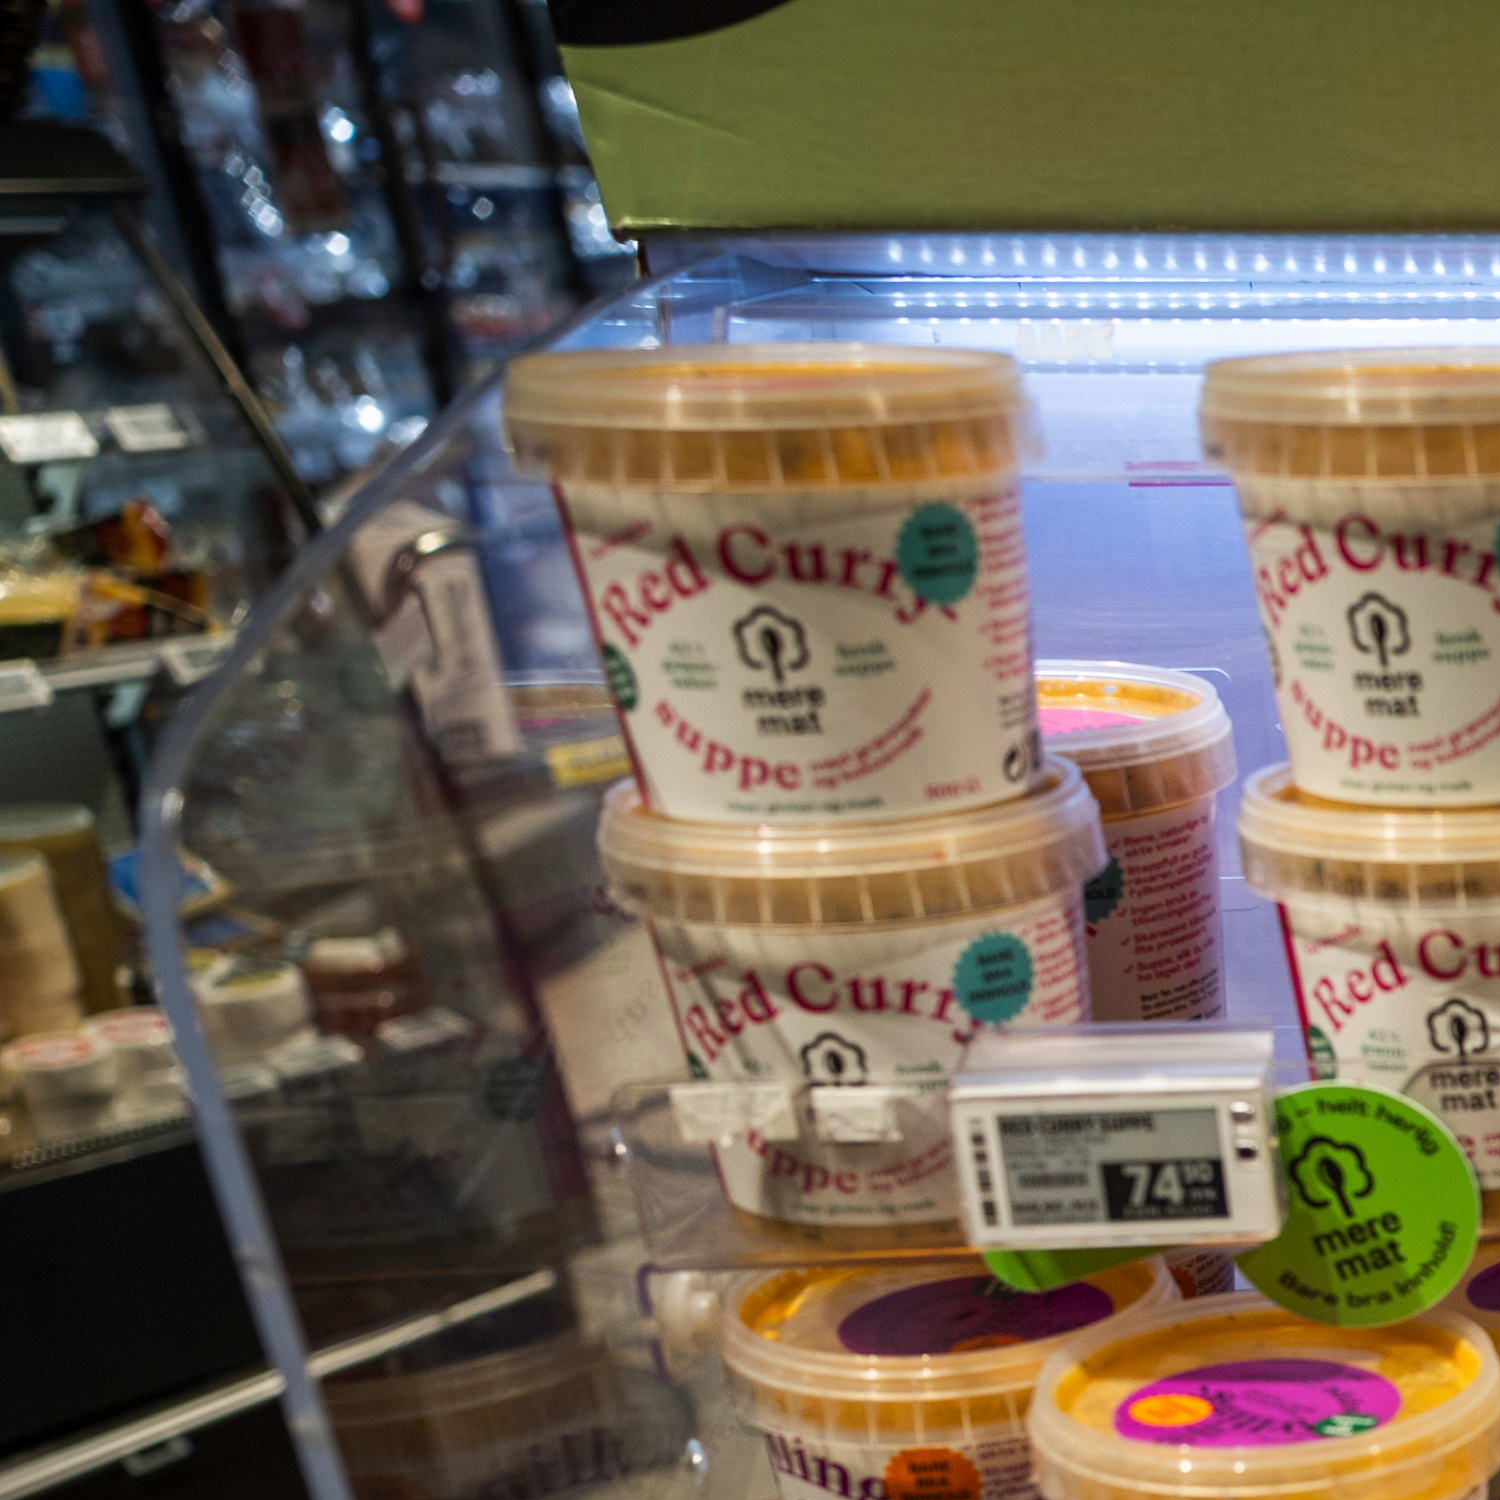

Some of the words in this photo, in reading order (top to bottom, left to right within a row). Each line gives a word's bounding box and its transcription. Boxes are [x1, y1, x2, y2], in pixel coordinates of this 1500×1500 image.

[603, 535, 709, 648] Red
[742, 685, 825, 708] mere
[1354, 672, 1423, 694] mere
[757, 712, 824, 737] mat
[1290, 682, 1402, 771] suppe
[1364, 695, 1421, 718] mat
[655, 702, 803, 791] suppe
[1313, 940, 1409, 1034] Red
[688, 980, 780, 1065] Red
[1441, 1089, 1499, 1111] mat
[1121, 1162, 1185, 1209] 74
[1313, 1212, 1403, 1258] mere
[1335, 1239, 1407, 1281] mat
